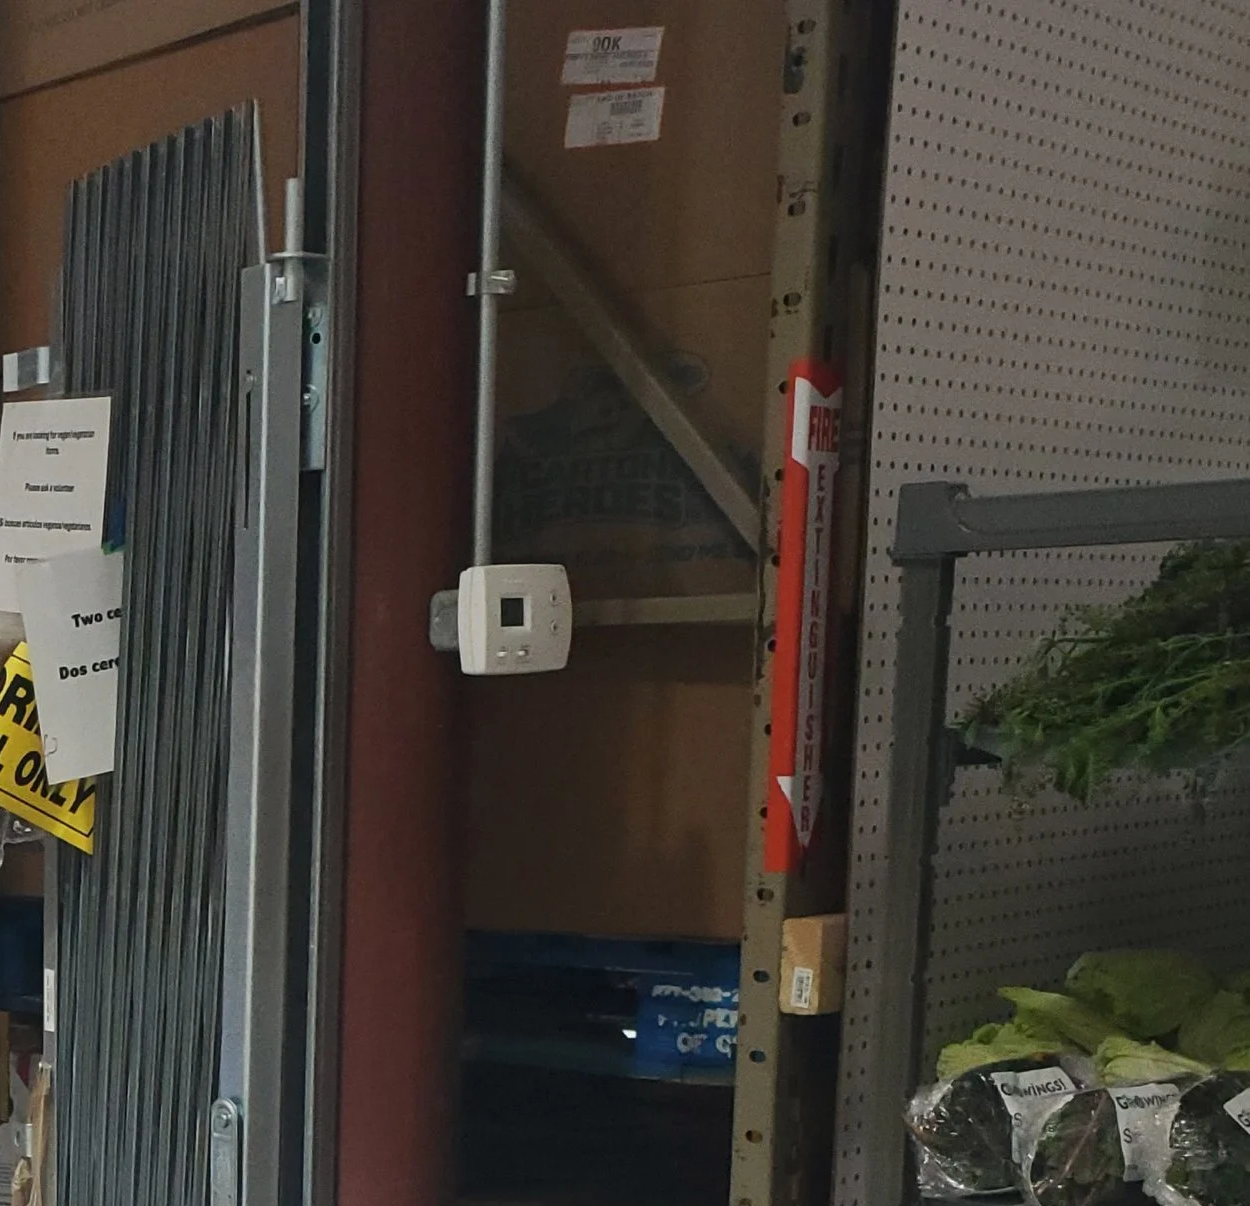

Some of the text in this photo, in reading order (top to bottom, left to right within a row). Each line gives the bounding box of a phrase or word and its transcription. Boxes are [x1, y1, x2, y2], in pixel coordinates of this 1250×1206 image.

[808, 405, 840, 452] FIRE
[71, 612, 103, 628] Two
[59, 665, 88, 680] Dos
